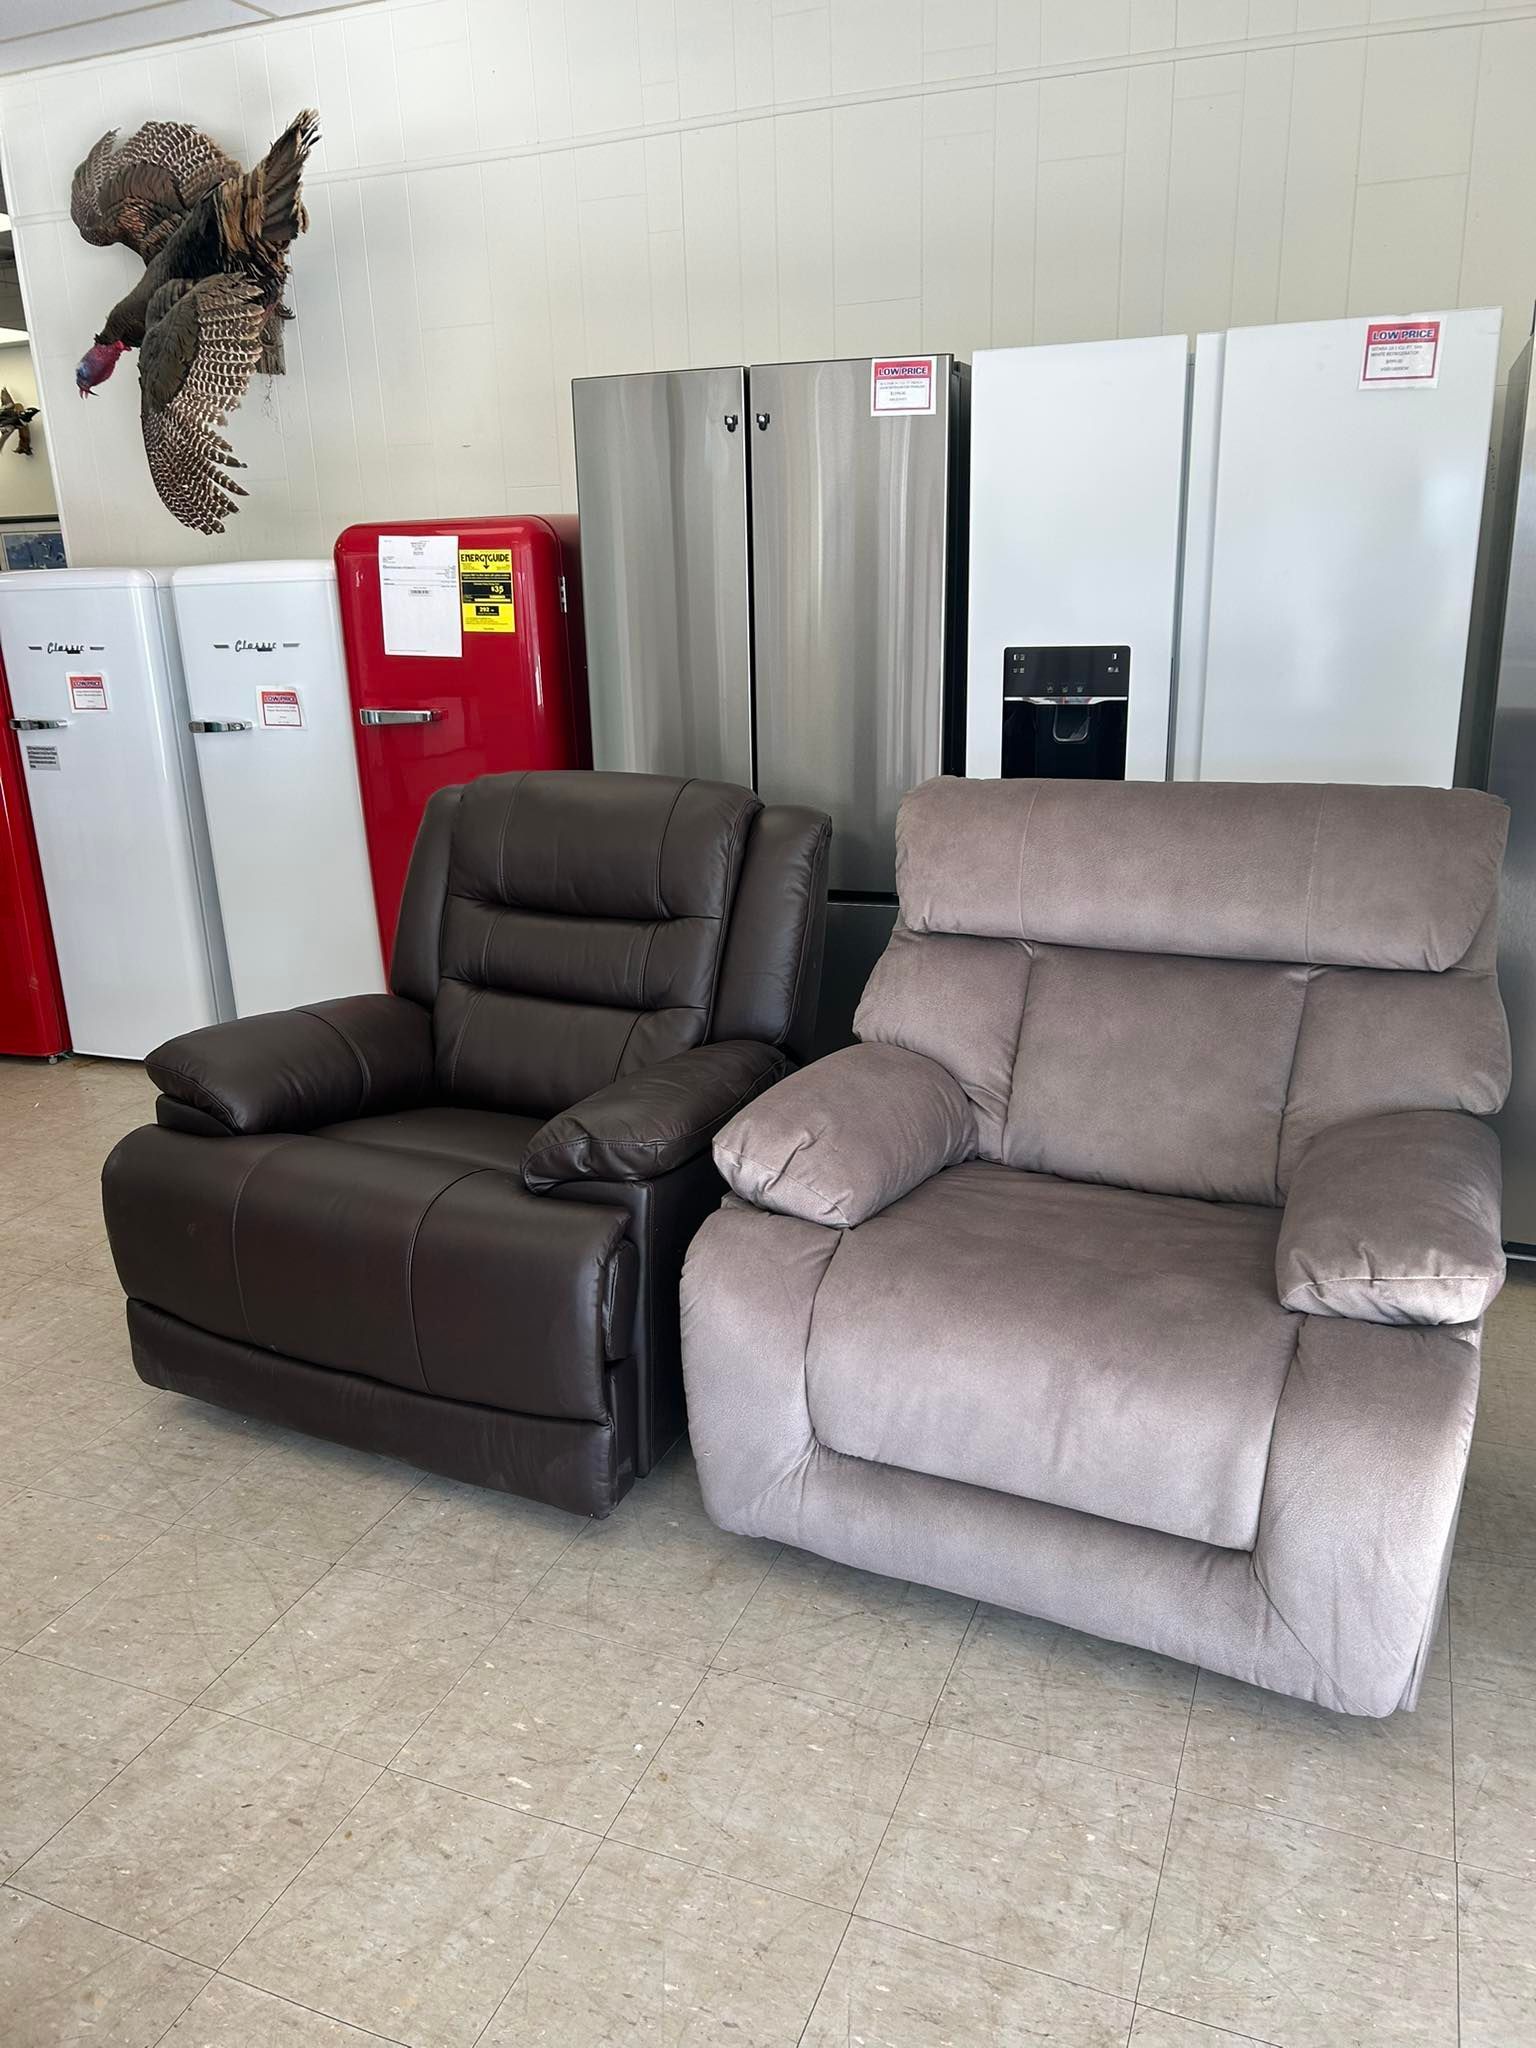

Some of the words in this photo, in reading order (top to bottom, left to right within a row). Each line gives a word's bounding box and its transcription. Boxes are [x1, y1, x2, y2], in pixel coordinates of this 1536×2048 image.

[1373, 331, 1399, 340] LOW
[1401, 329, 1434, 339] PRICE
[879, 367, 899, 376] LOW
[901, 366, 927, 375] PRICE
[460, 553, 510, 563] ENERGYGUIDE
[47, 642, 84, 654] Classic
[235, 640, 277, 652] Classic
